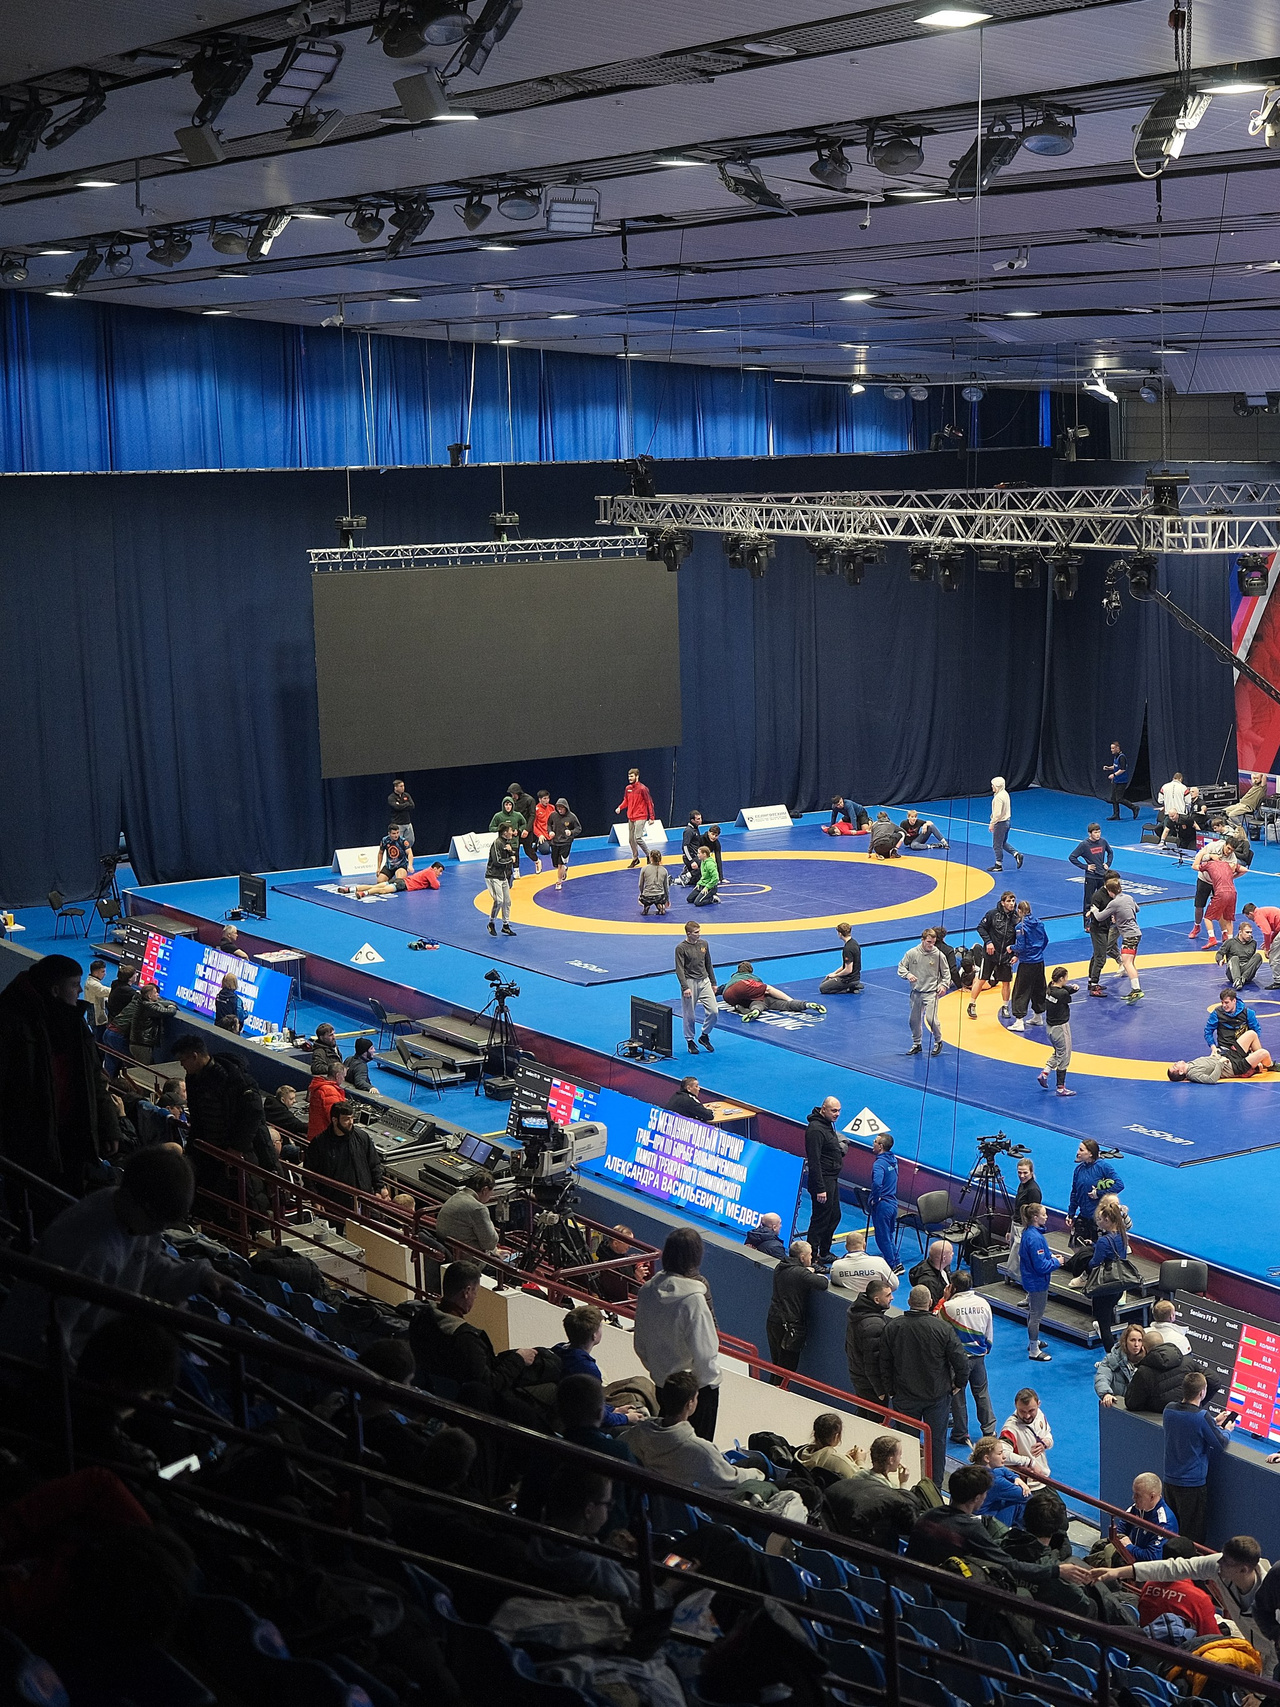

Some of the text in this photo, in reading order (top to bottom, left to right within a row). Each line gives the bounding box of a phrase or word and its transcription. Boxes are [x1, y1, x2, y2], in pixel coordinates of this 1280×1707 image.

[365, 951, 376, 961] C
[850, 1118, 863, 1132] B
[867, 1118, 881, 1132] B
[604, 1154, 764, 1229] АЛЕКСАНДРА ВАСИЛЬЕВИЧА МЕДВЕД
[838, 1269, 876, 1278] BELARUS
[956, 1306, 984, 1316] BELARUS
[1145, 1586, 1187, 1603] EGYPT
